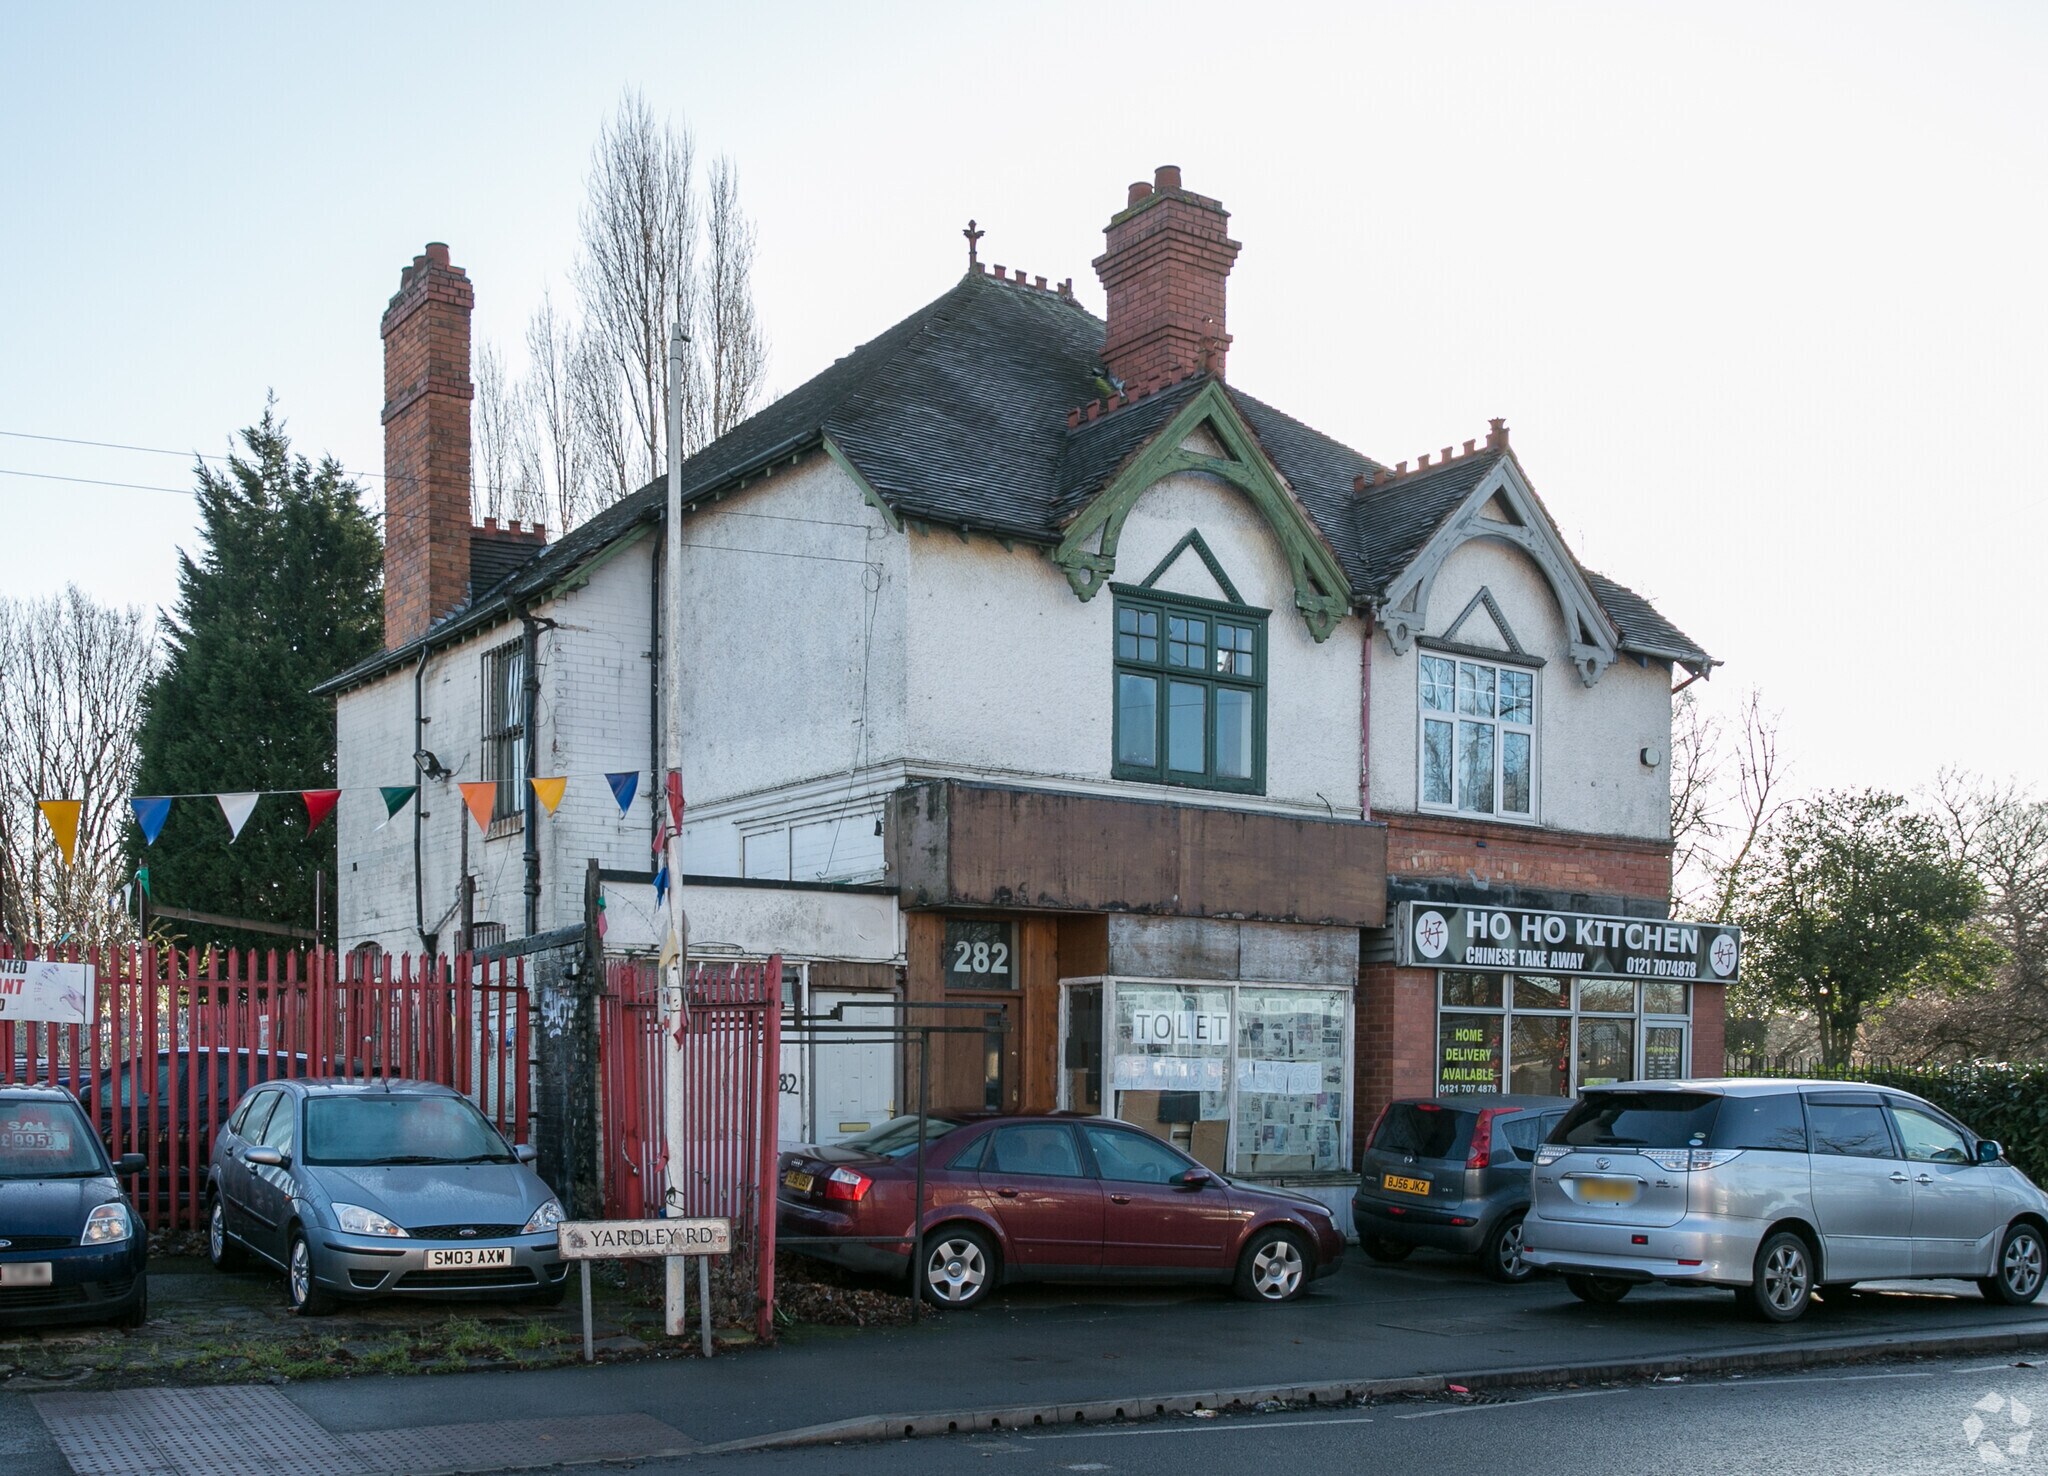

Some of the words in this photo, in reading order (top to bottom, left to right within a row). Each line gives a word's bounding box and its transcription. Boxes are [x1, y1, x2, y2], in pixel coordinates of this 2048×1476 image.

[1420, 918, 1444, 951] 好
[1466, 911, 1511, 940] HO
[1521, 915, 1567, 944] HO
[1575, 918, 1698, 955] KITCHEN
[953, 940, 1009, 974] 282
[1466, 946, 1515, 966] CHINESE
[1518, 949, 1547, 967] TAKE
[1550, 951, 1585, 969] AWAY
[1626, 956, 1650, 974] 0121
[1653, 959, 1697, 978] 7074878
[1455, 1028, 1484, 1042] HOME
[1445, 1047, 1492, 1061] DELIVERY
[1442, 1067, 1494, 1081] AVAILABLE
[1439, 1084, 1459, 1093] 0121
[1461, 1084, 1476, 1093] 707
[1477, 1084, 1497, 1093] 4878
[1387, 1176, 1408, 1190] BJ56
[1409, 1182, 1426, 1192] JKZ
[590, 1228, 678, 1247] YARDLEY
[686, 1227, 713, 1244] RD
[717, 1235, 727, 1243] 27
[434, 1250, 473, 1265] SM03
[477, 1249, 505, 1264] AXW
